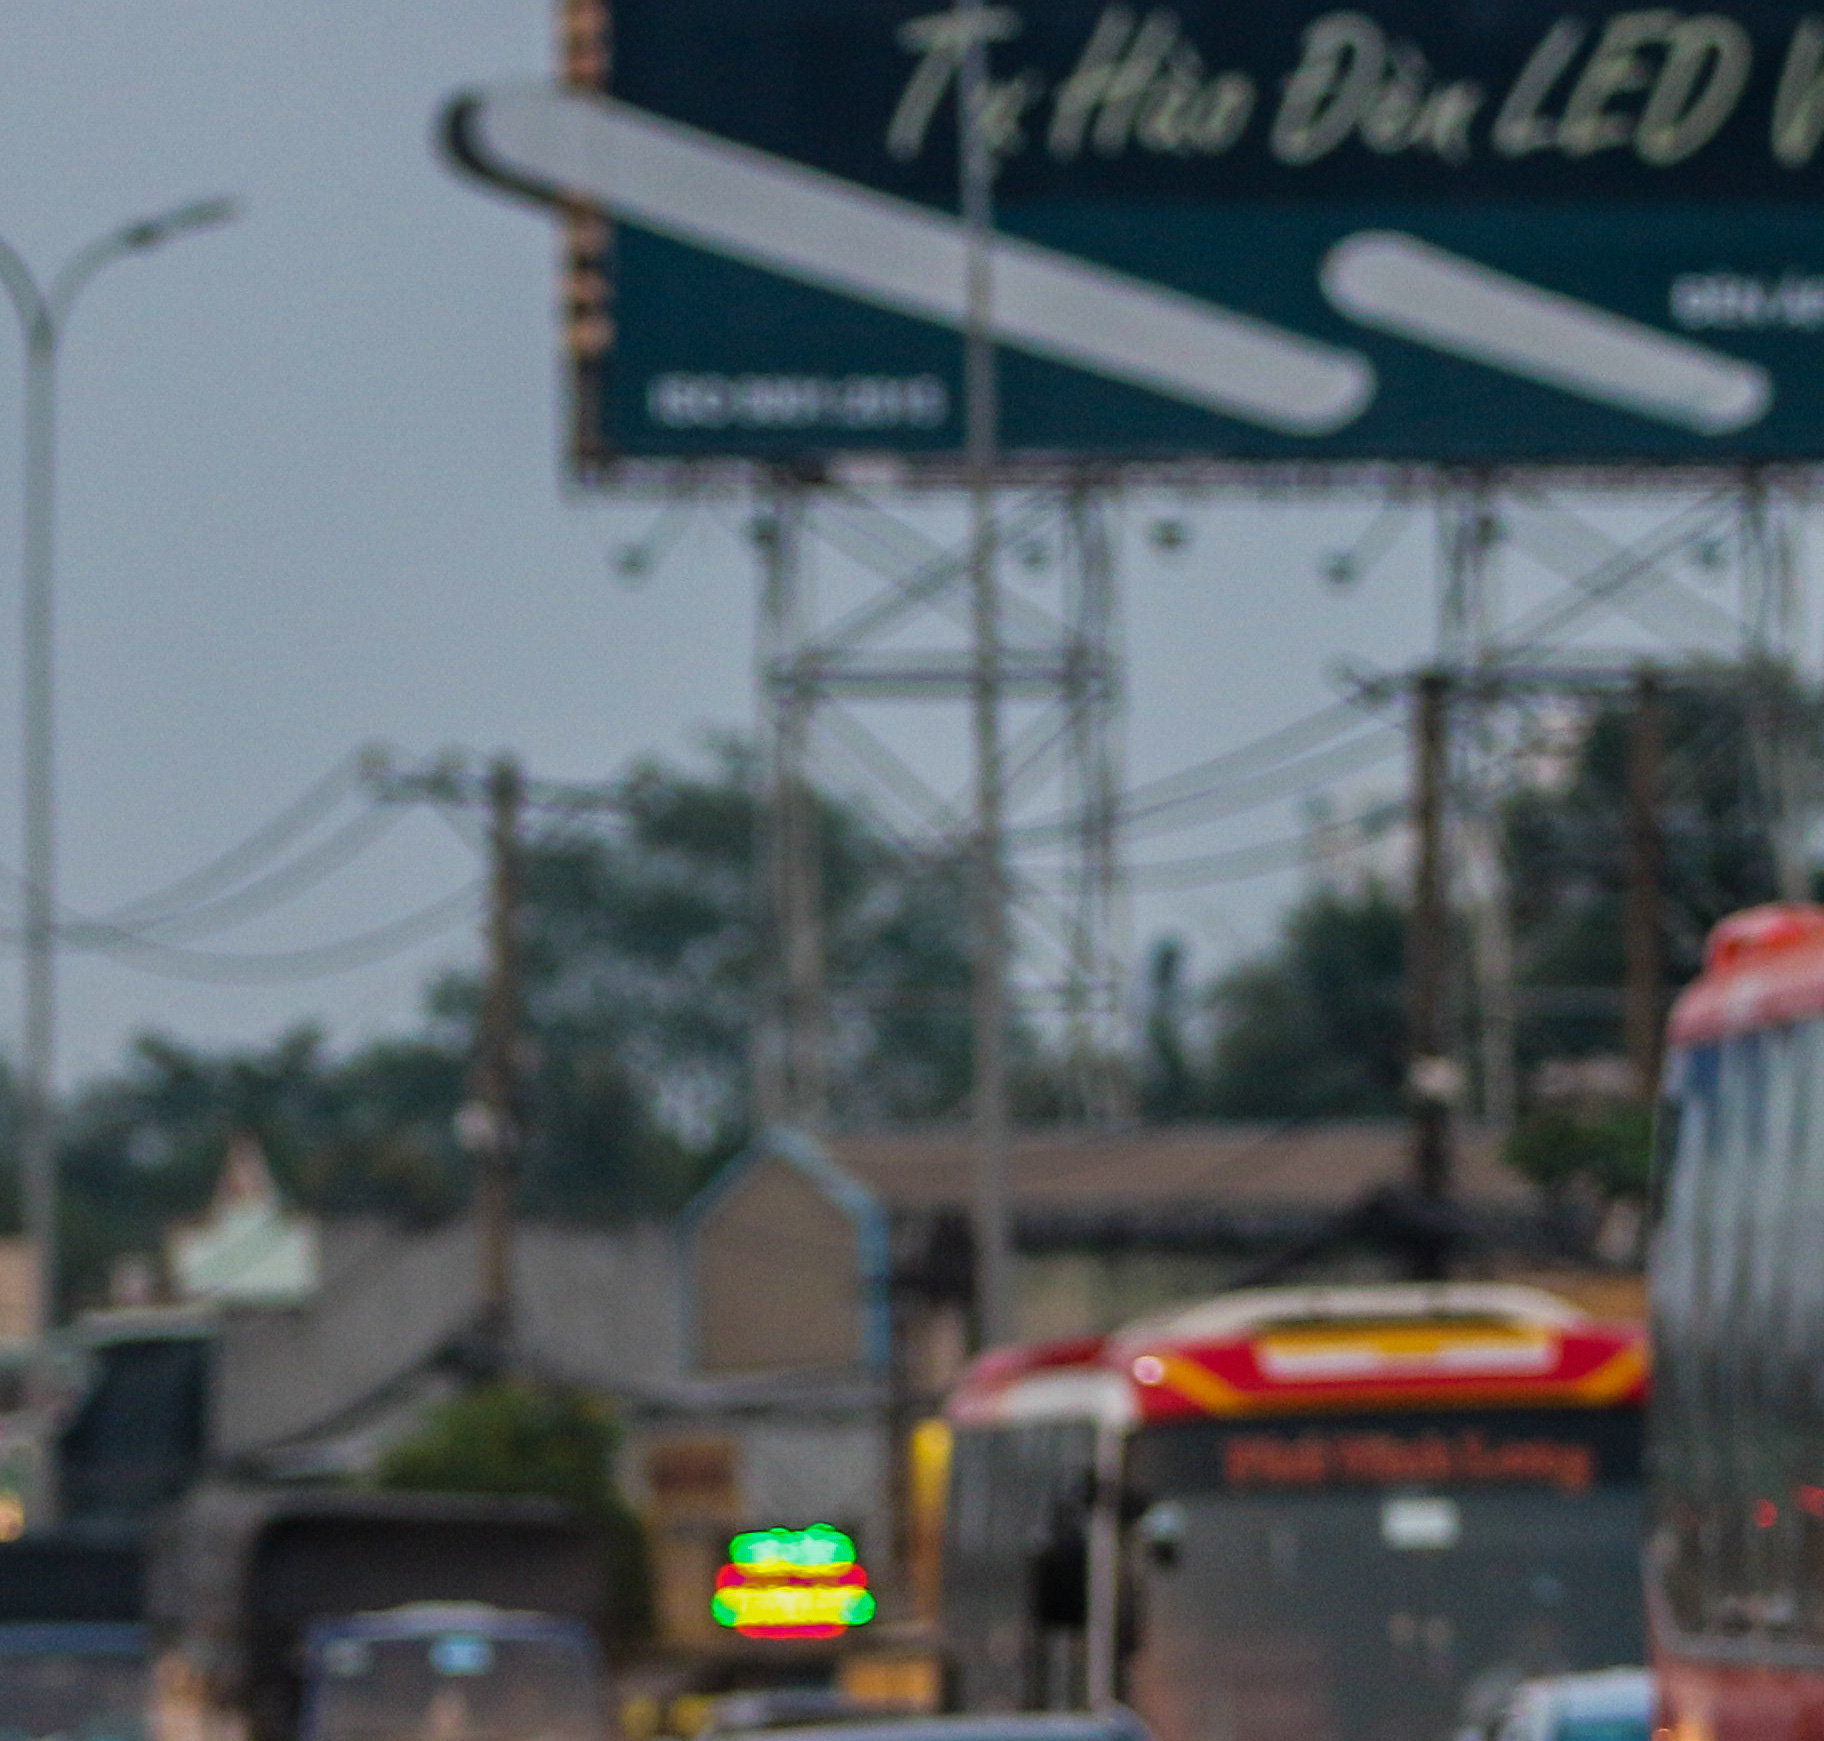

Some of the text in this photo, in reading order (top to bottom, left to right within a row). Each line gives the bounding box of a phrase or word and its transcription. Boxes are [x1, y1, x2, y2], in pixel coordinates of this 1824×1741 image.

[1047, 5, 1253, 157] Hào
[1271, 11, 1478, 164] Đèn
[1492, 11, 1753, 166] LED
